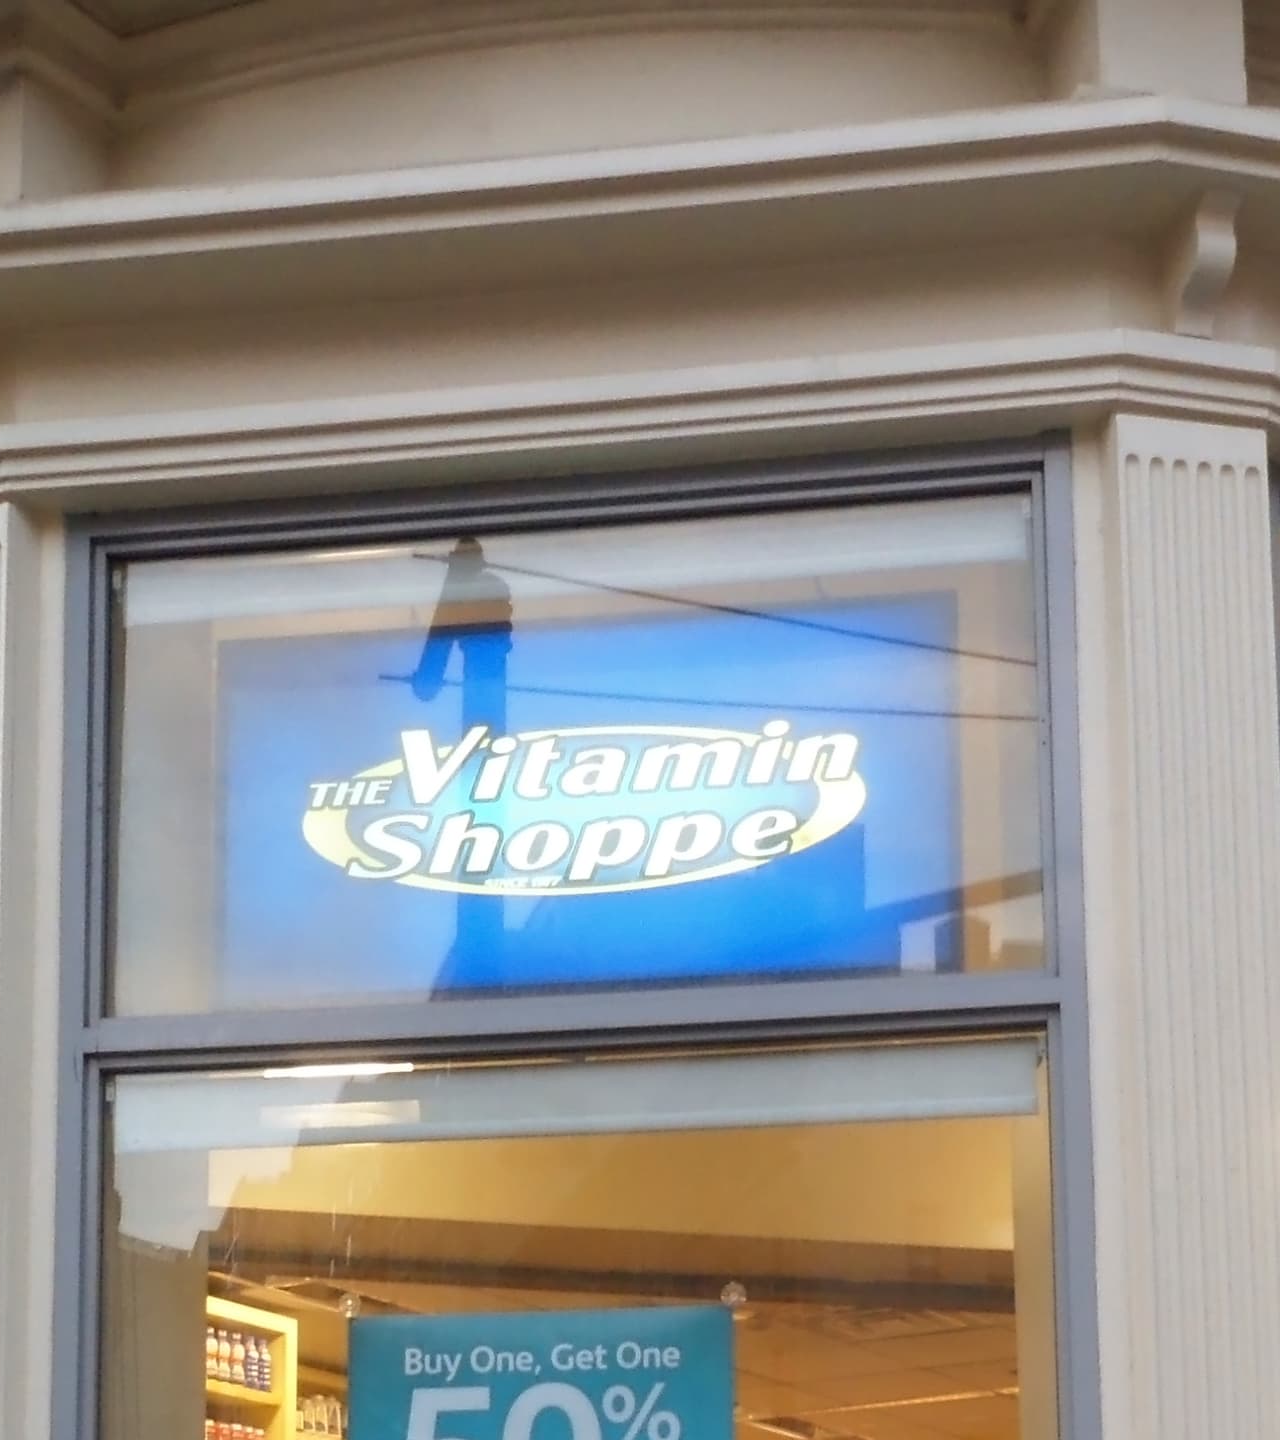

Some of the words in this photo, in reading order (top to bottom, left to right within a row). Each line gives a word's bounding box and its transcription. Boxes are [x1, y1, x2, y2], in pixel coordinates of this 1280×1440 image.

[309, 780, 393, 809] THE
[400, 720, 860, 806] Vitamin
[347, 809, 800, 881] Shoppe
[404, 1348, 462, 1381] Buy
[470, 1345, 541, 1374] One,
[550, 1343, 607, 1370] Get
[616, 1341, 681, 1368] One
